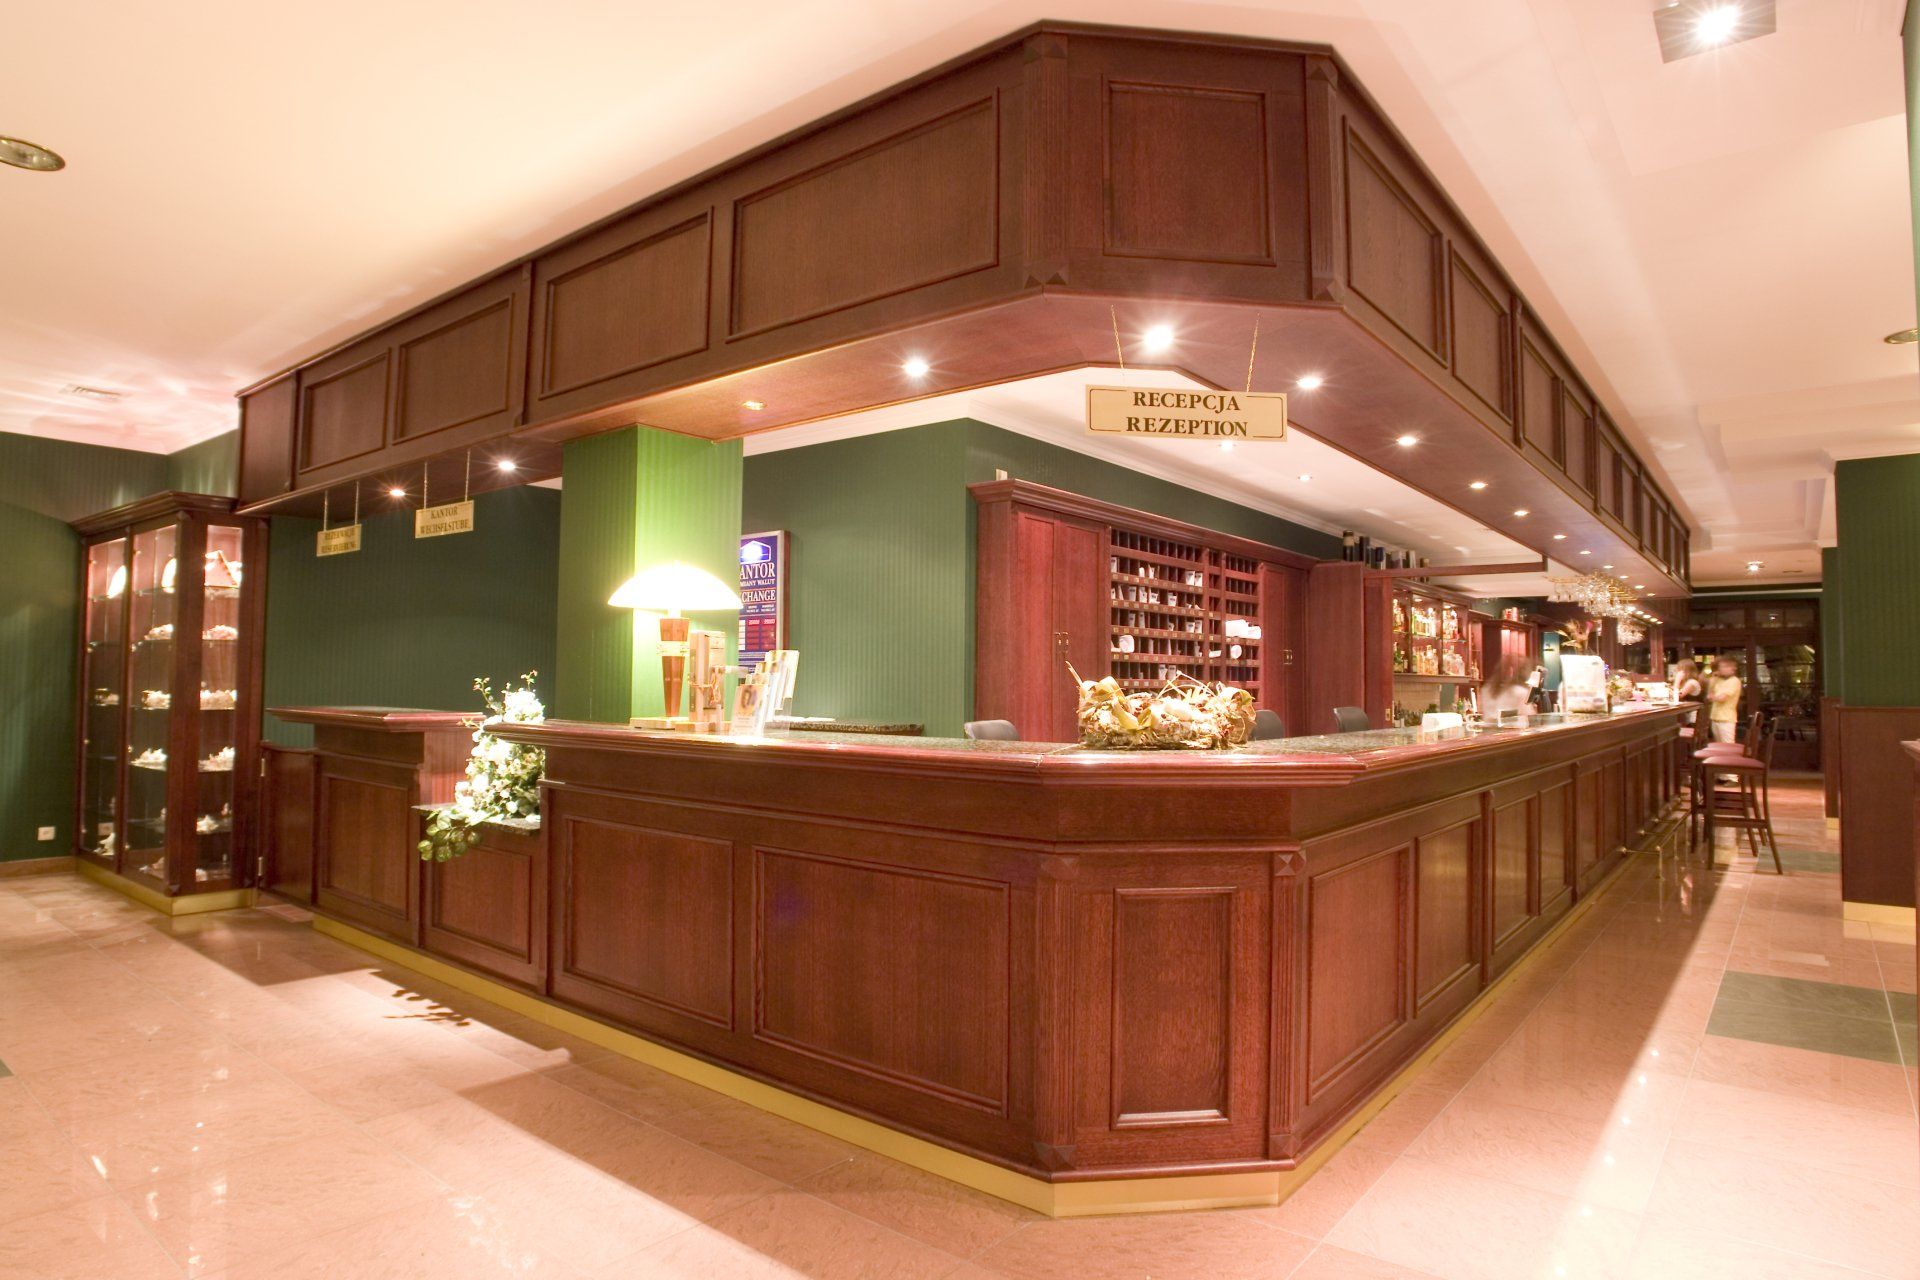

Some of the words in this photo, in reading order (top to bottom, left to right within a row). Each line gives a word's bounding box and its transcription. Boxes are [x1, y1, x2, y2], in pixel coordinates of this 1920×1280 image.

[1132, 391, 1241, 414] RECEPCJA
[1126, 416, 1248, 437] REZEPTION
[430, 506, 458, 519] KANTOR
[740, 562, 776, 580] ANTOR
[742, 590, 776, 602] CHANGE
